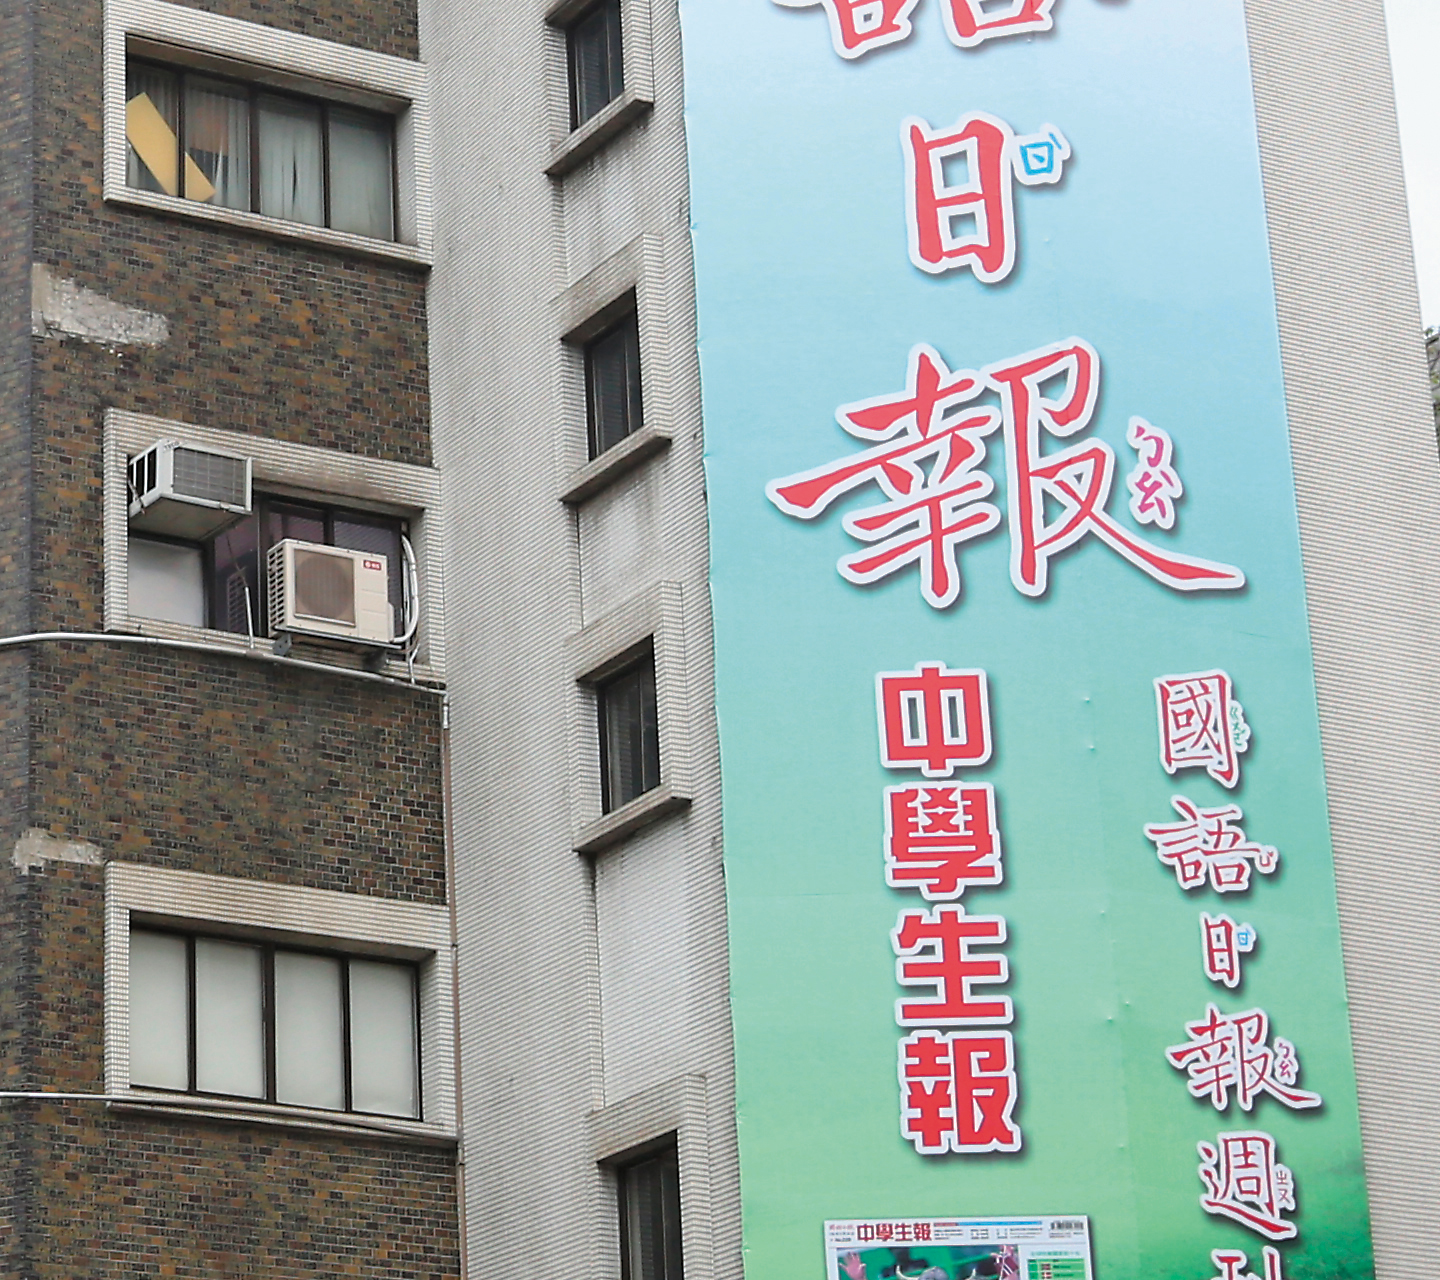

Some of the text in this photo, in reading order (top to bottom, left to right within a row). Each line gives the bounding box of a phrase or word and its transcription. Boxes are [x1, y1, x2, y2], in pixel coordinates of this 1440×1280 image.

[875, 661, 1022, 1156] 中學生報
[857, 1222, 932, 1242] 中學生報
